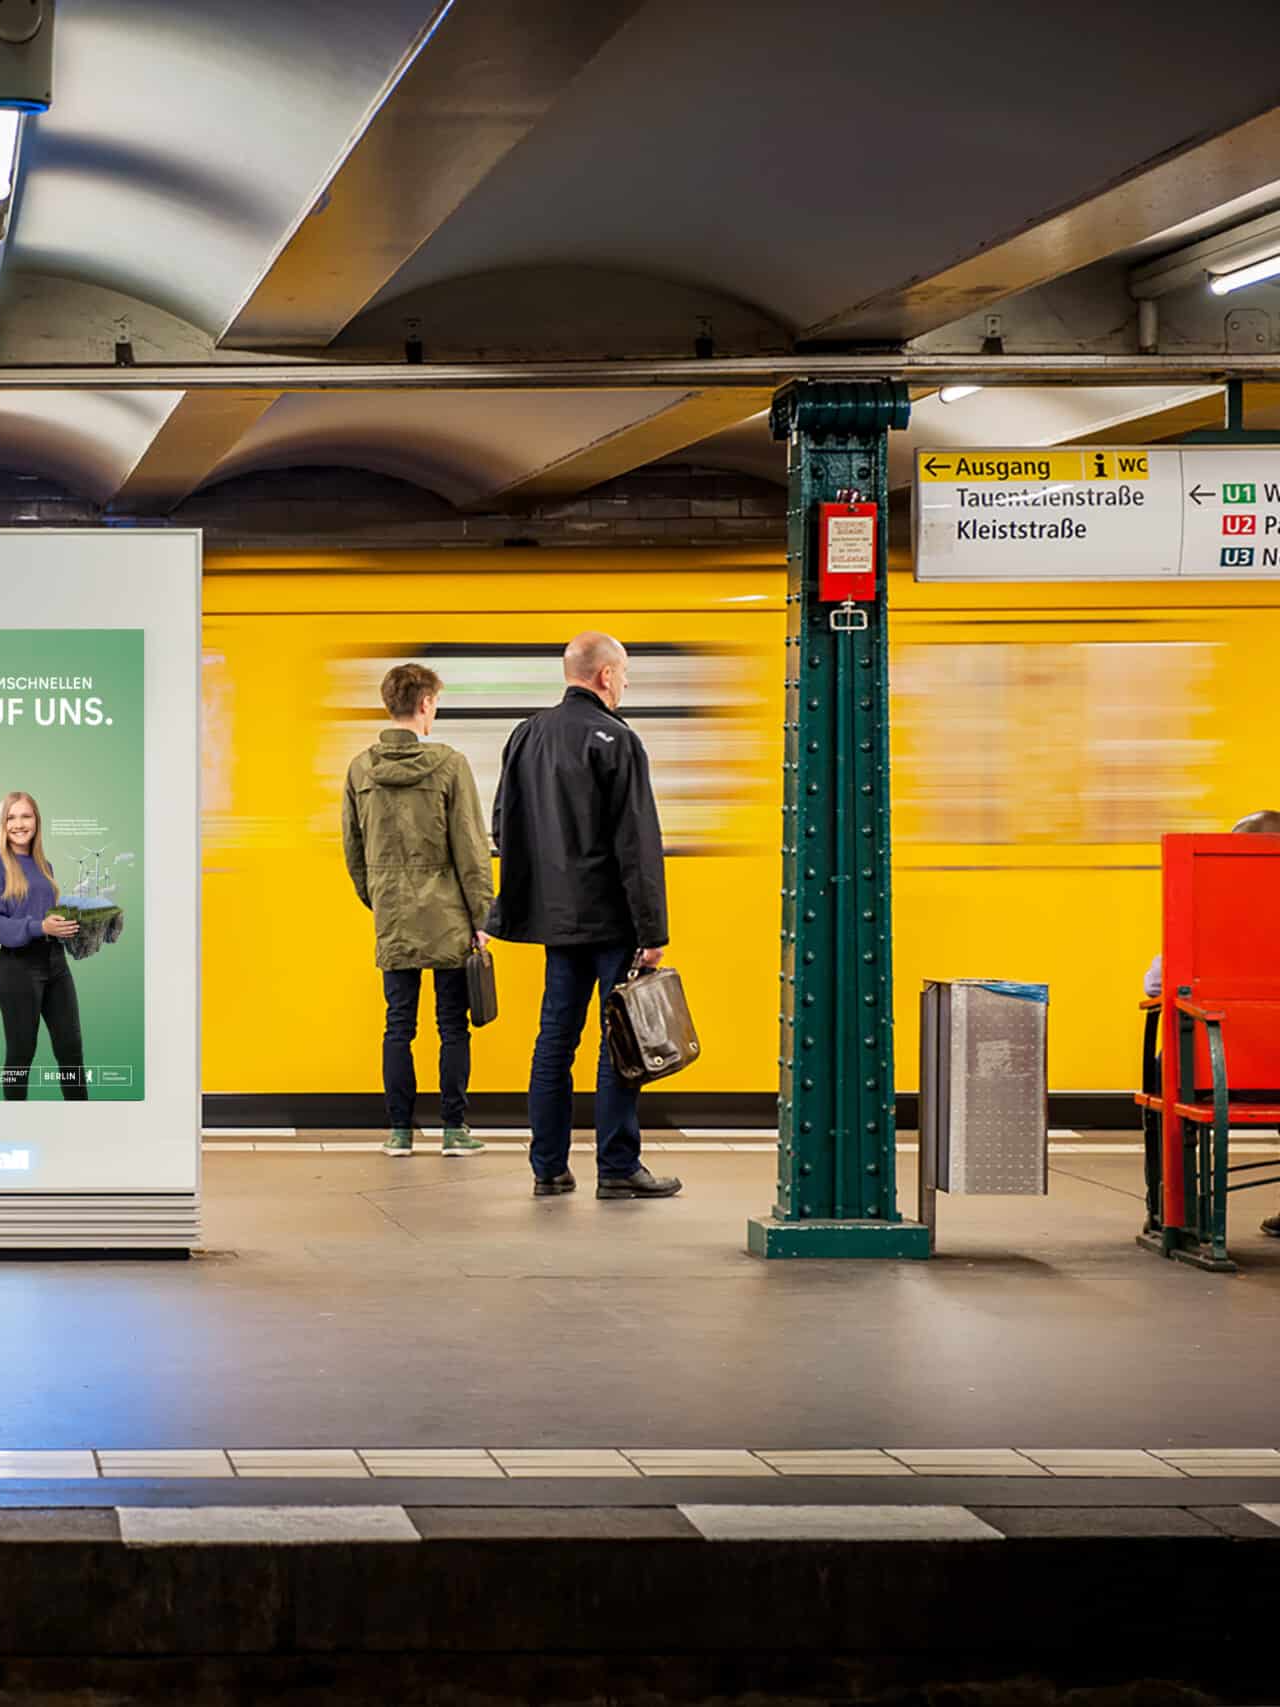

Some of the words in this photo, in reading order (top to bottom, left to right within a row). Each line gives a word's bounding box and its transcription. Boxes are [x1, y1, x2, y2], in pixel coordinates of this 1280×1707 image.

[956, 457, 1051, 480] Ausgang
[1119, 457, 1148, 473] WC
[956, 485, 1145, 508] Tauentzienstraße
[1226, 485, 1251, 502] U1
[957, 517, 1087, 540] Kleiststraße
[1226, 516, 1253, 533] U2
[1224, 549, 1251, 565] U3
[35, 697, 113, 727] UNS.
[44, 1071, 76, 1081] BERLIN
